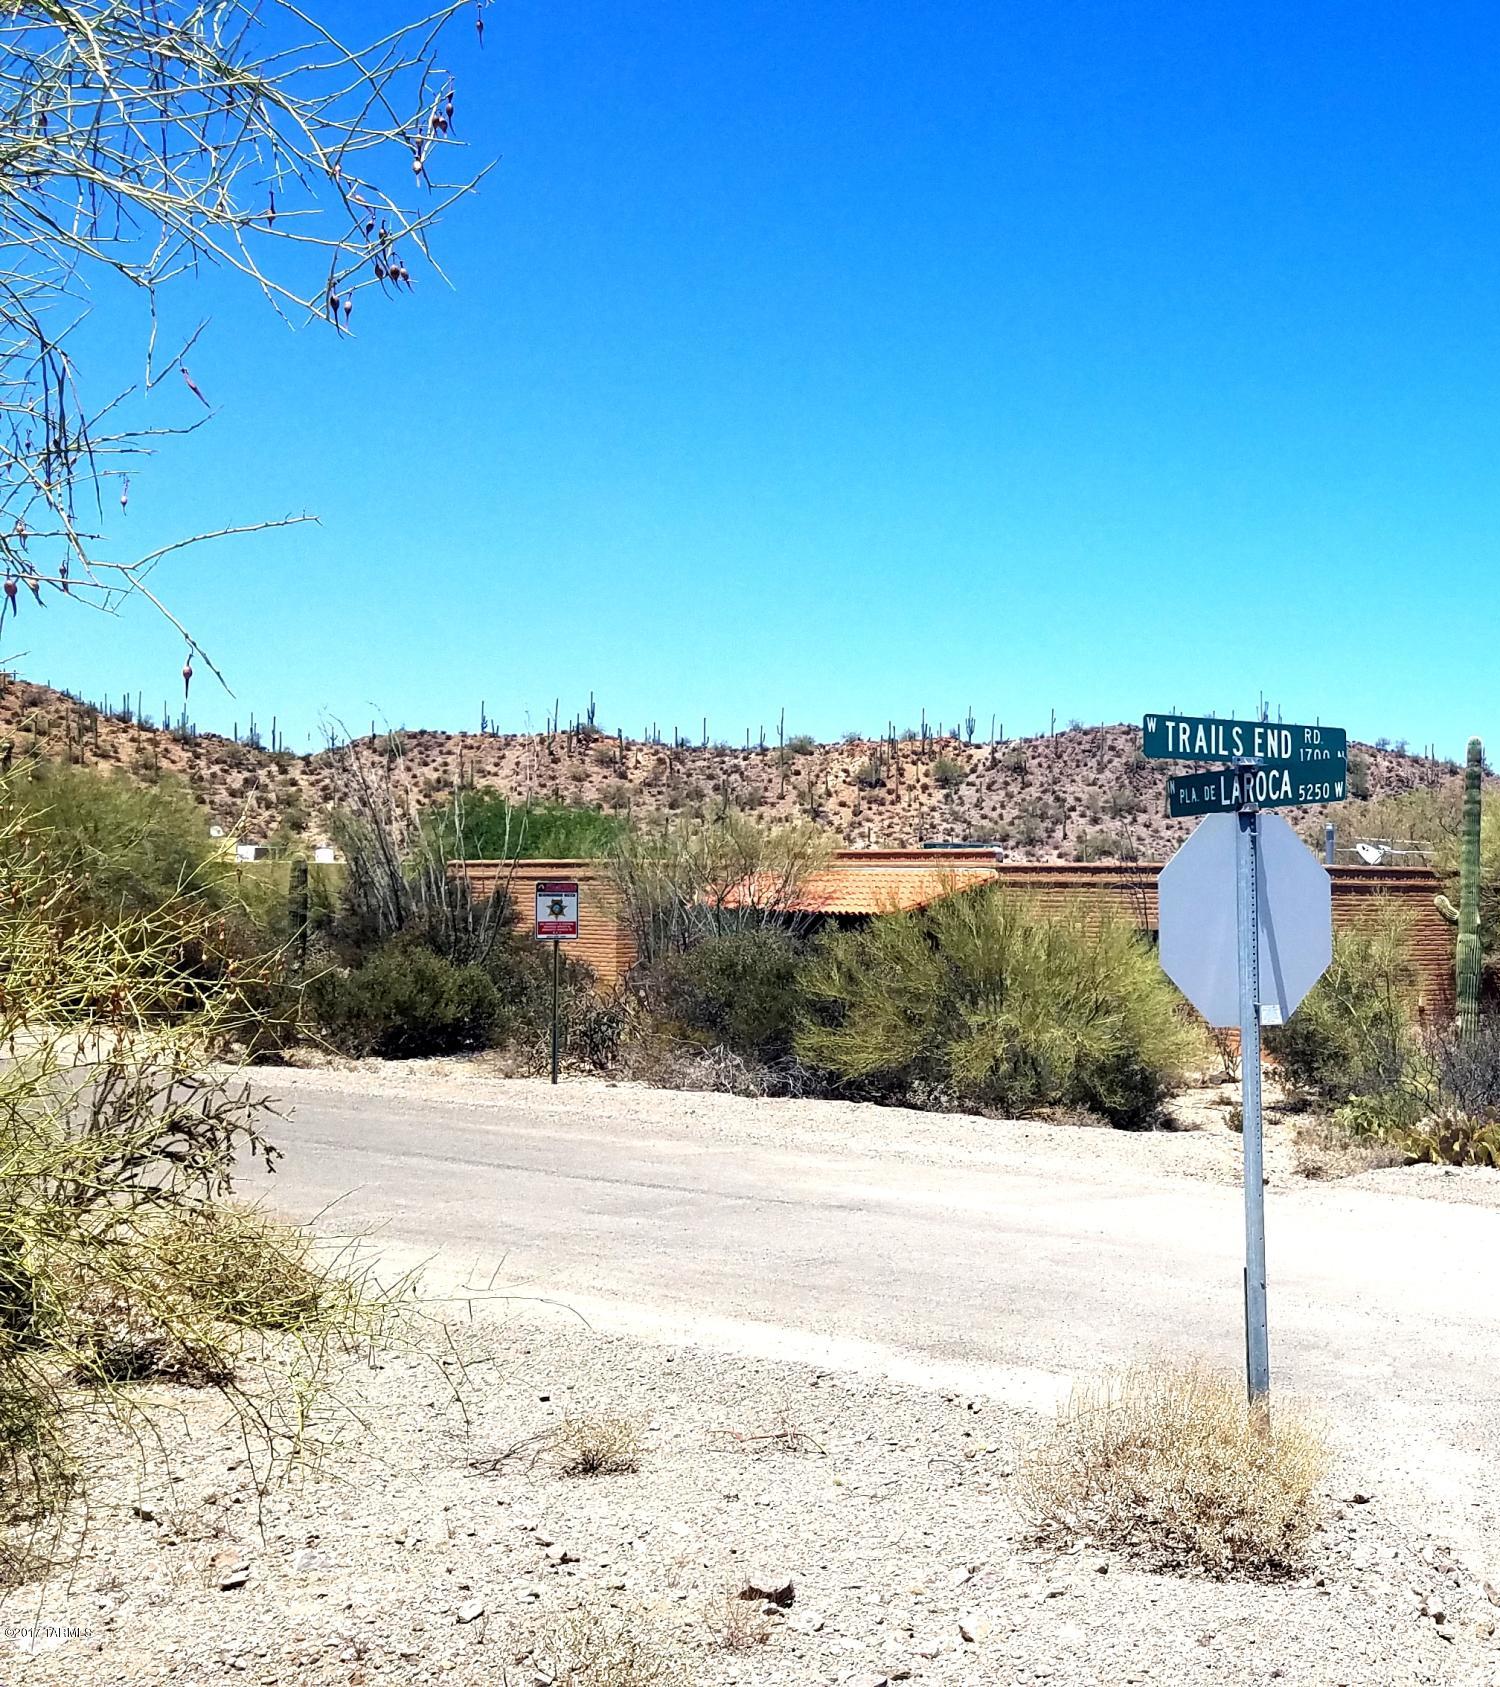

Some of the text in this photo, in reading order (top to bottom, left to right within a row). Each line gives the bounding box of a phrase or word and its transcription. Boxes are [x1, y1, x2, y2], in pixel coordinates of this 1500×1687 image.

[1146, 717, 1157, 733] W
[1165, 721, 1244, 756] TRAILS
[1254, 727, 1292, 759] END
[1204, 785, 1216, 801] DE
[1299, 782, 1330, 801] 5250
[1334, 781, 1344, 798] W
